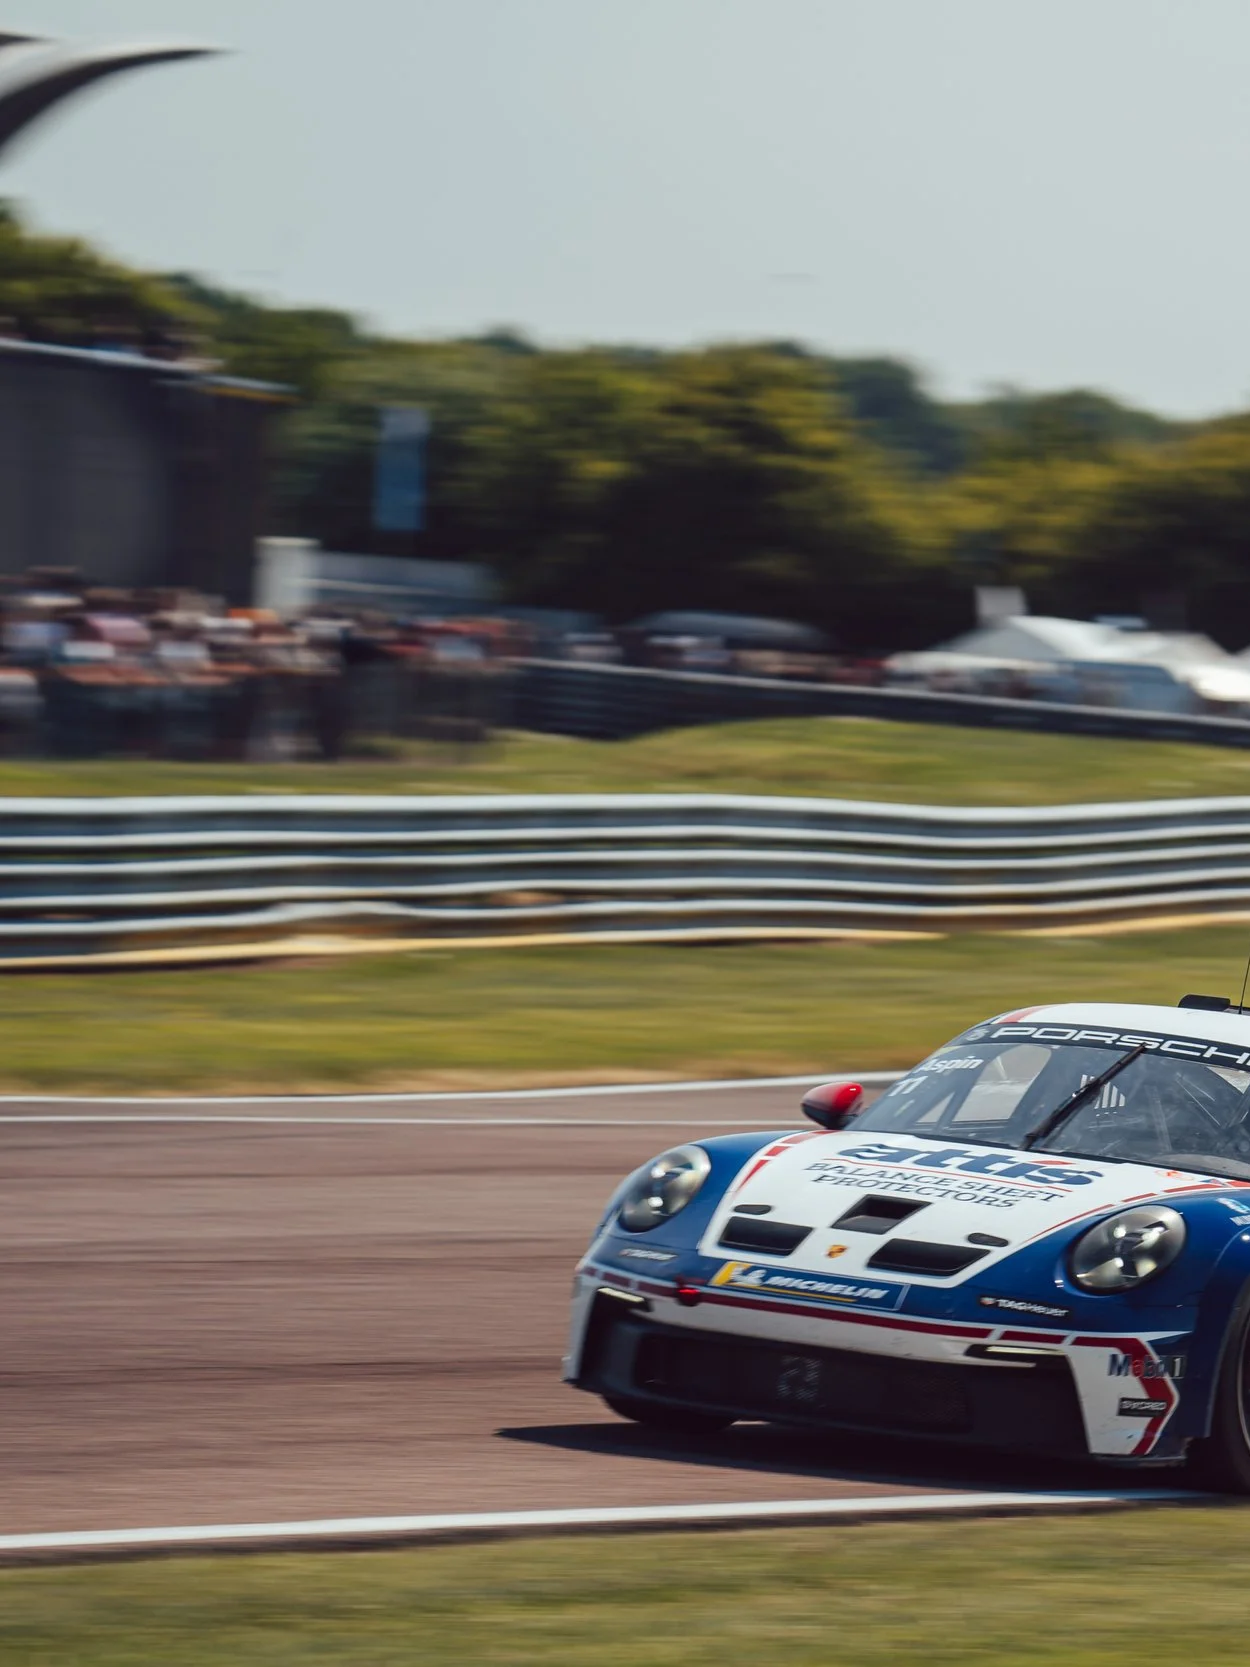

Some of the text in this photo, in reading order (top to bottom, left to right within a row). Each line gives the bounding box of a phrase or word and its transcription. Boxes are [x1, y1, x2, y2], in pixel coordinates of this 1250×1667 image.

[888, 1075, 929, 1096] 11
[836, 1143, 1104, 1186] attis
[804, 1161, 1064, 1203] BALANCE SHEET
[811, 1174, 1020, 1208] PROTECTORS
[765, 1275, 889, 1299] MICHELIN
